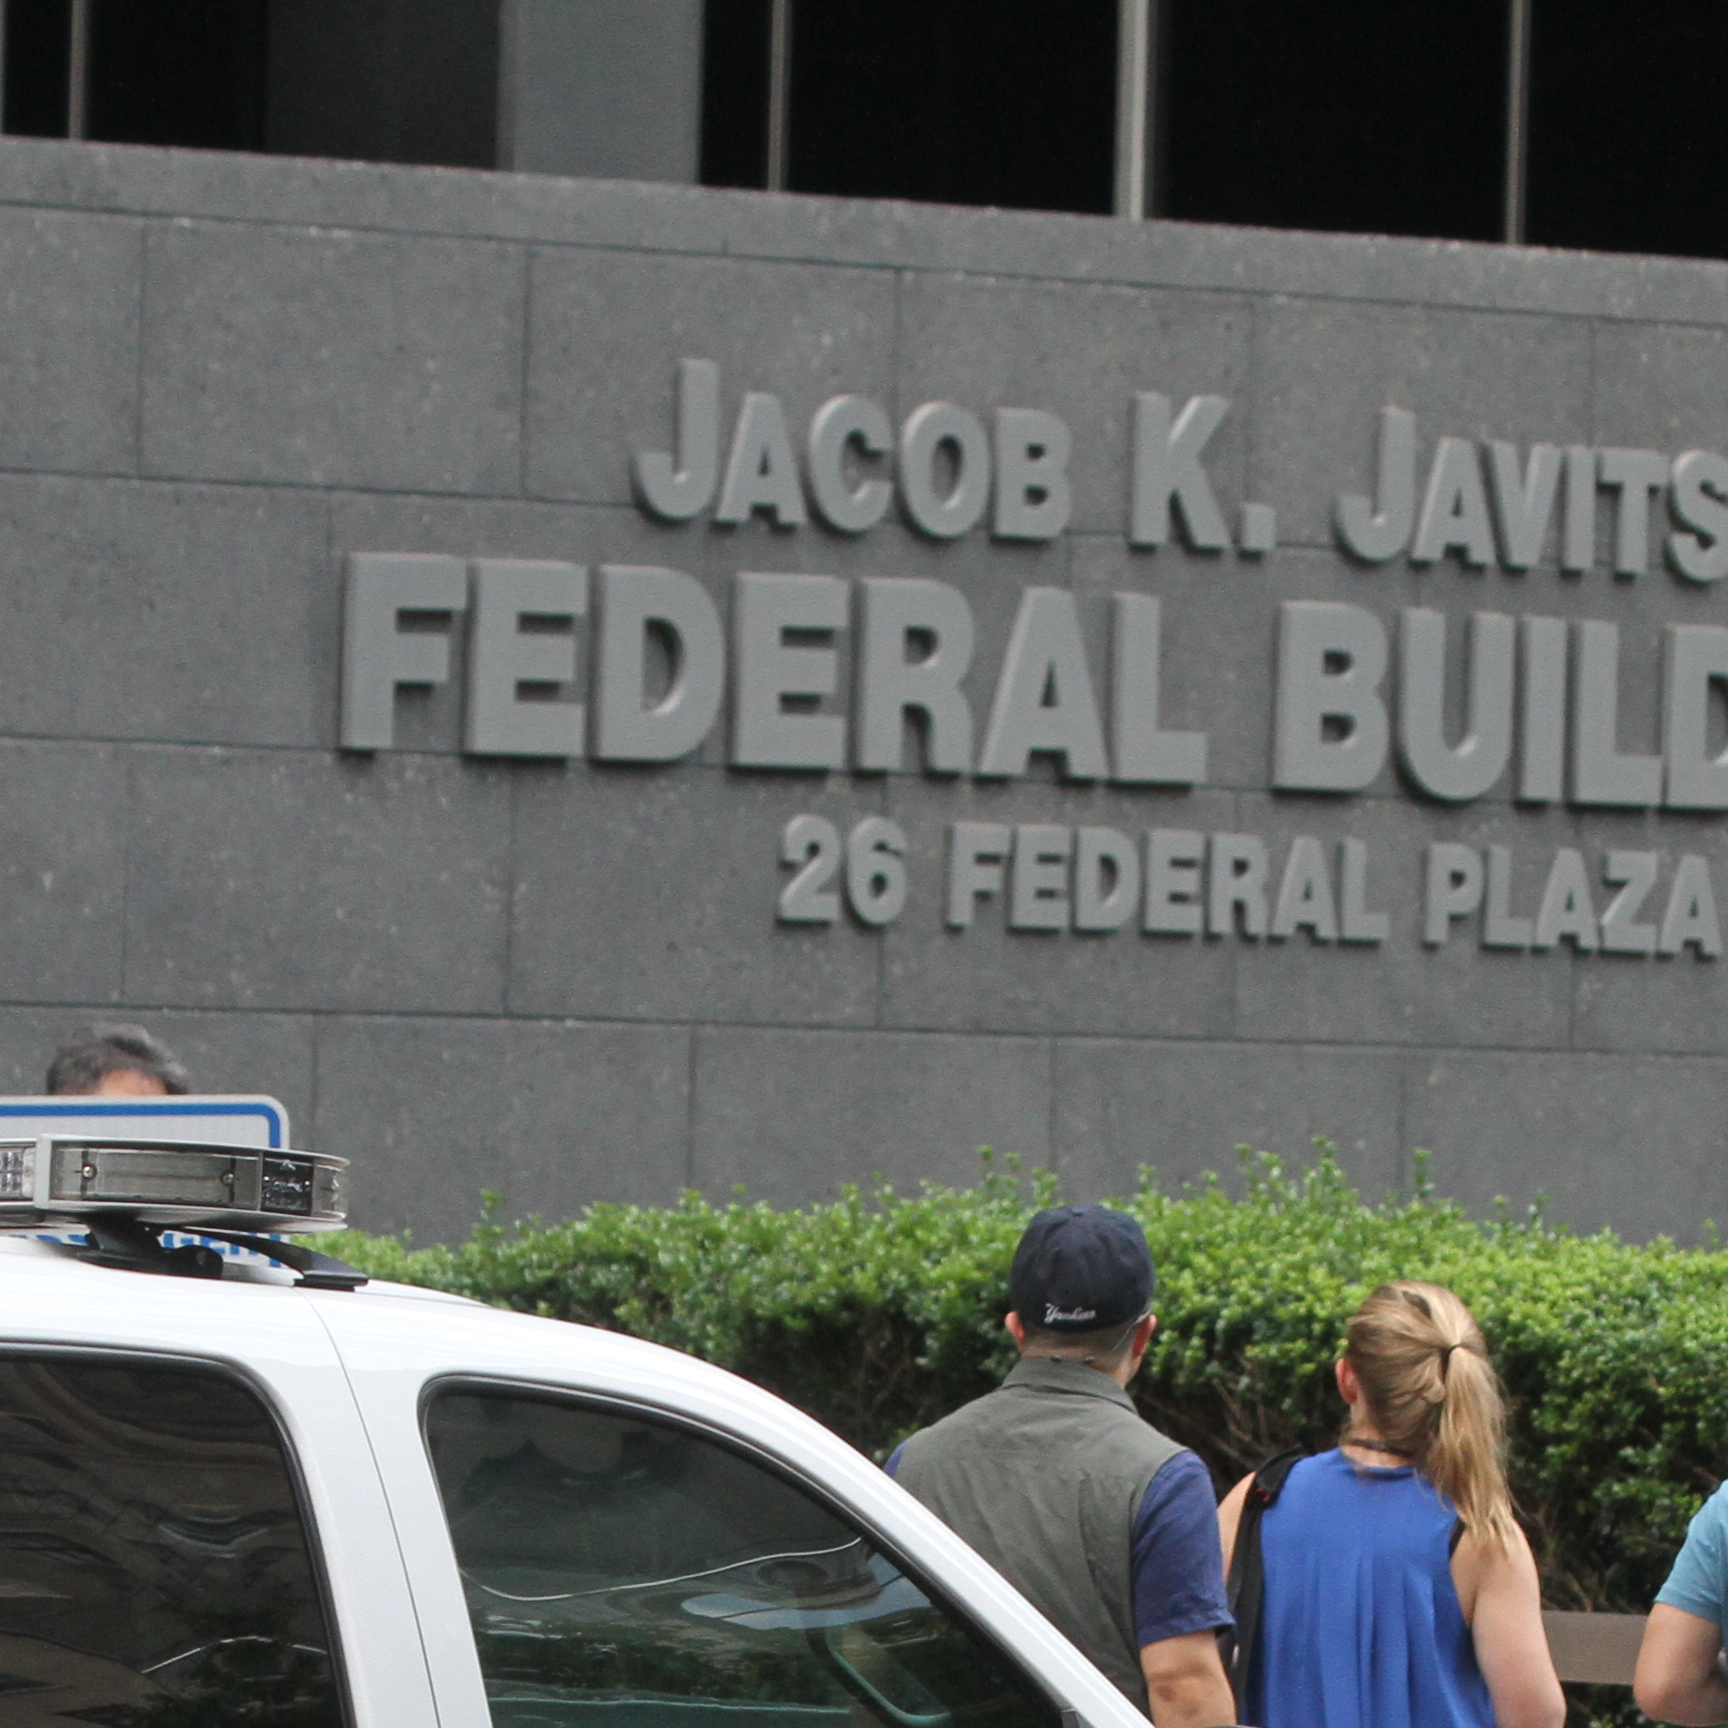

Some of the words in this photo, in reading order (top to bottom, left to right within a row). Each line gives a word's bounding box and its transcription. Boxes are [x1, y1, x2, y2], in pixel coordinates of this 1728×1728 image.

[631, 357, 1071, 539] JACOB
[1129, 390, 1276, 553] K.
[341, 551, 1208, 785] FEDERAL
[777, 813, 907, 925] 26
[947, 819, 1392, 943] FEDERAL
[1422, 841, 1722, 956] PLAZA
